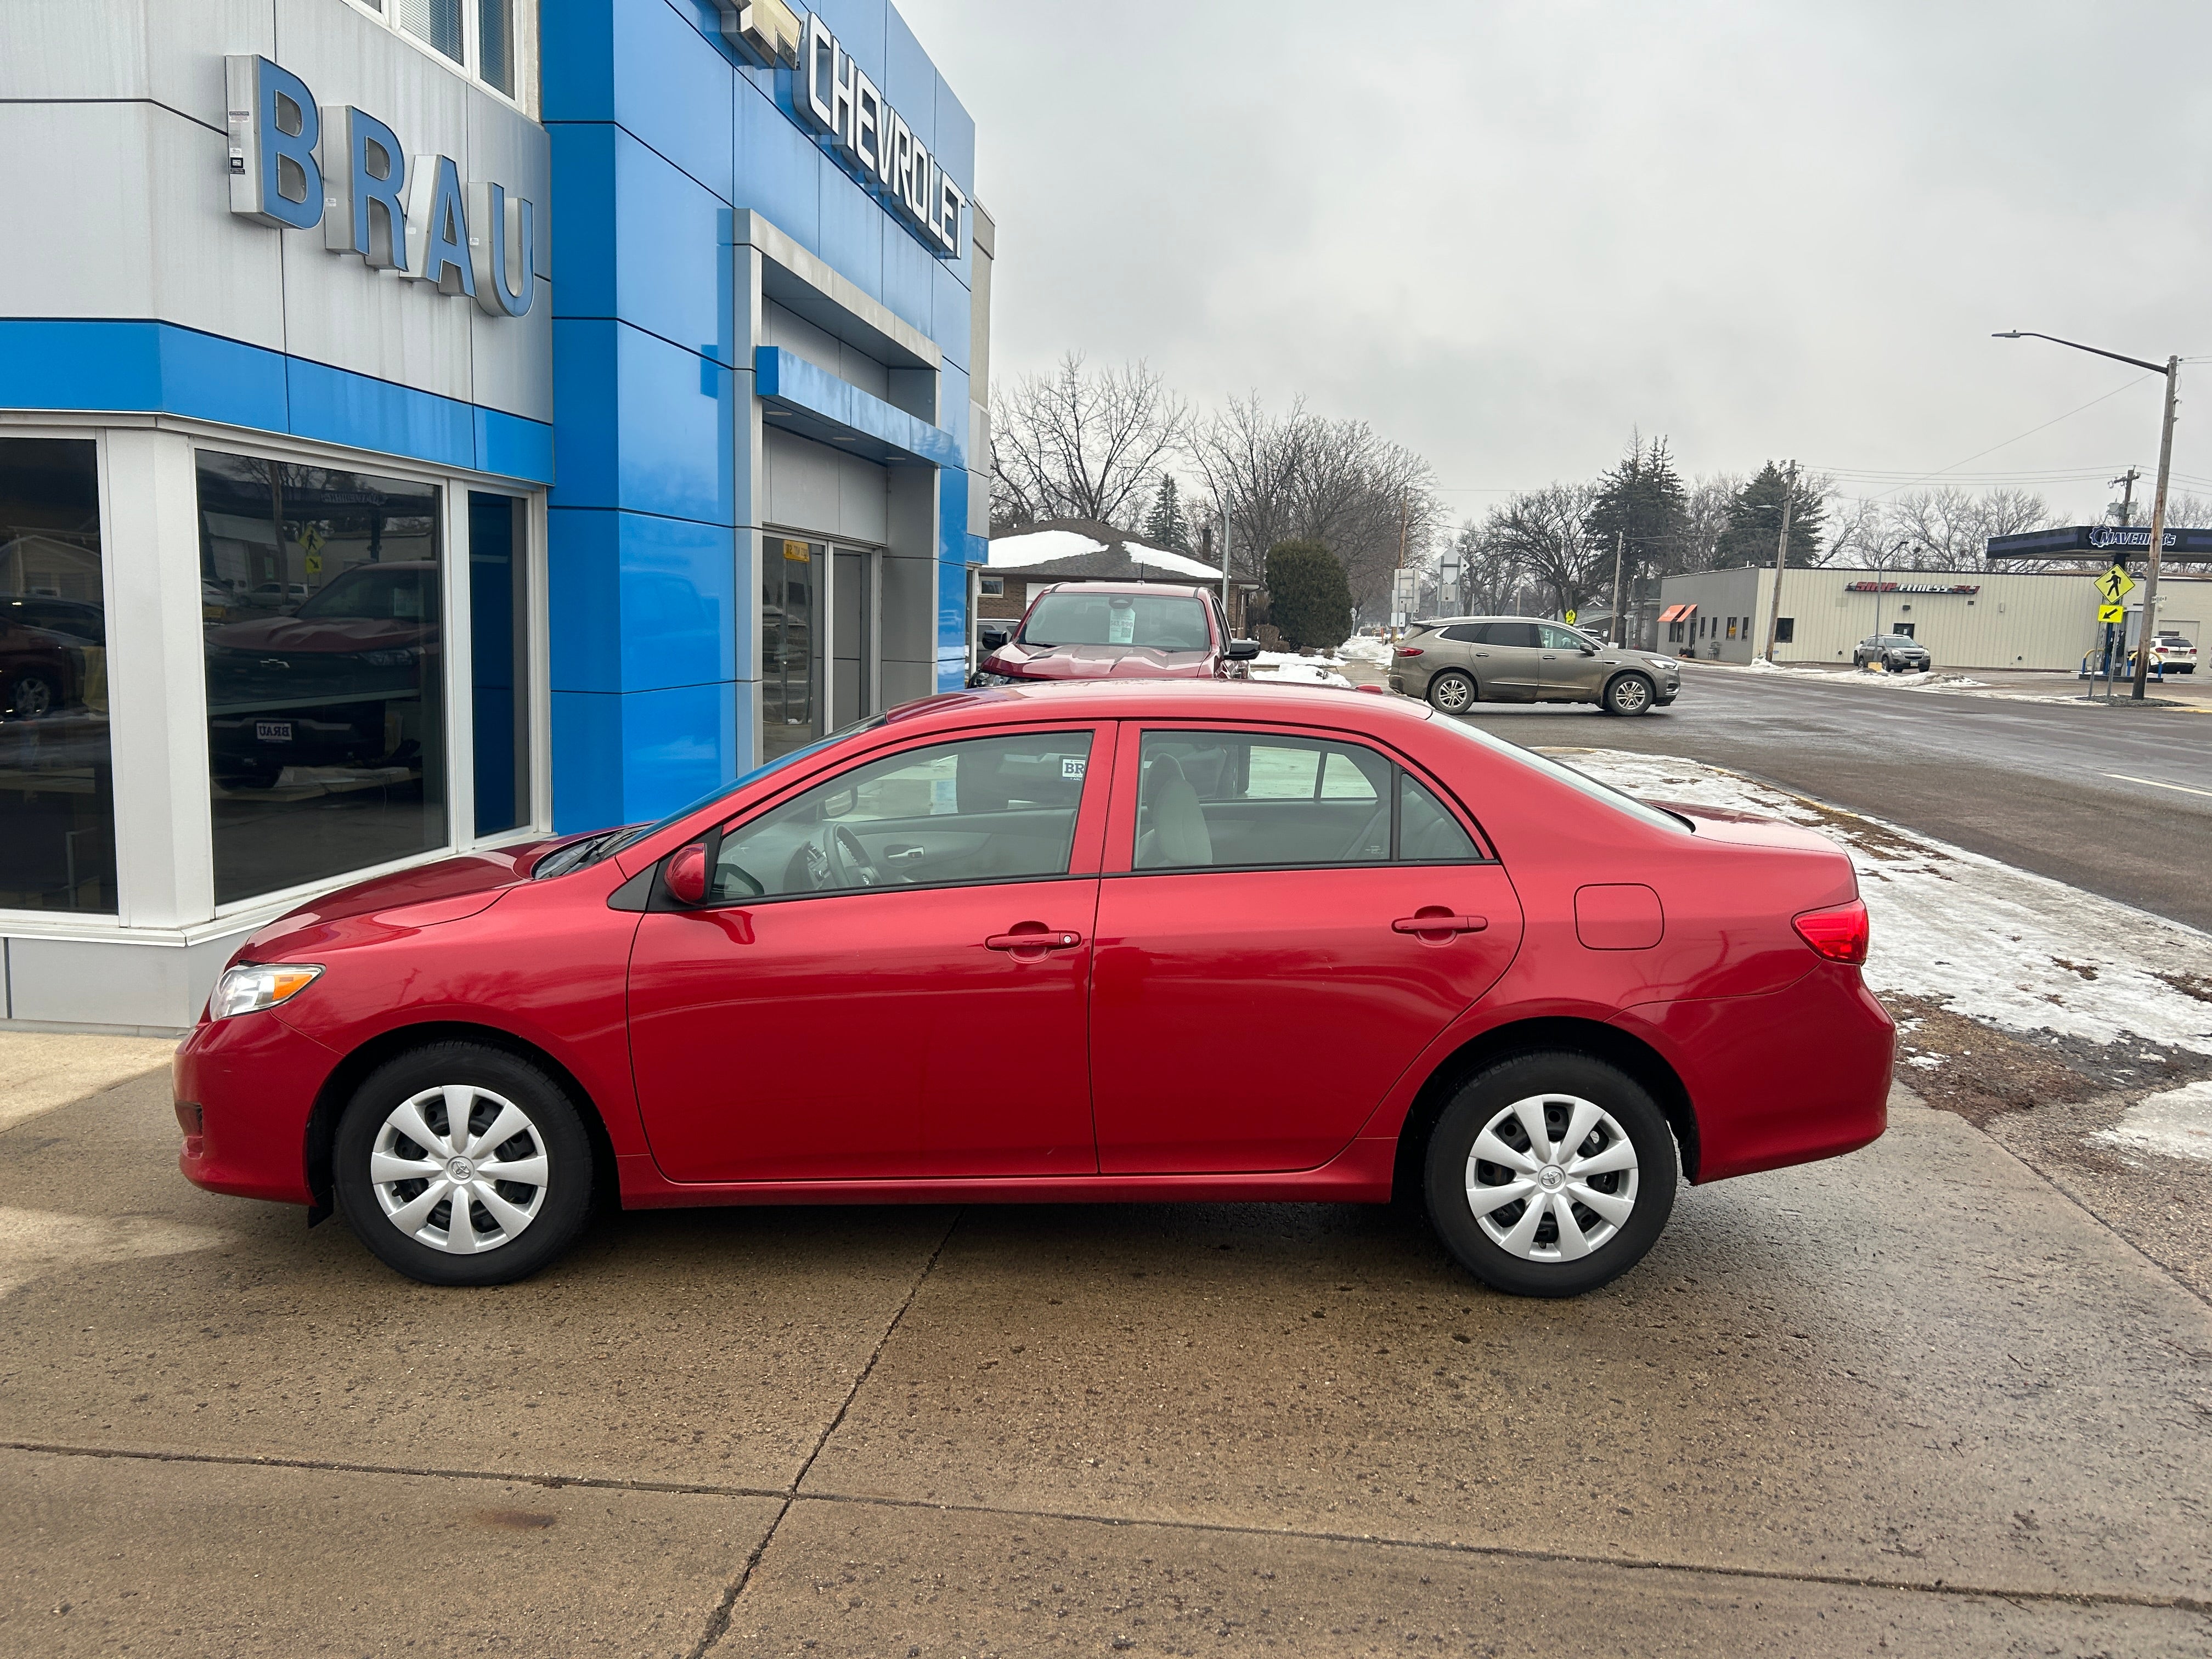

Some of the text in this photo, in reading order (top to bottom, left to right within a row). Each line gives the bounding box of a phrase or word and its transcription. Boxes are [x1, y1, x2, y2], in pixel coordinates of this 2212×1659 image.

[253, 54, 534, 318] BRAU
[806, 12, 966, 259] CHEVROLET
[1899, 584, 1948, 592] FITNESS
